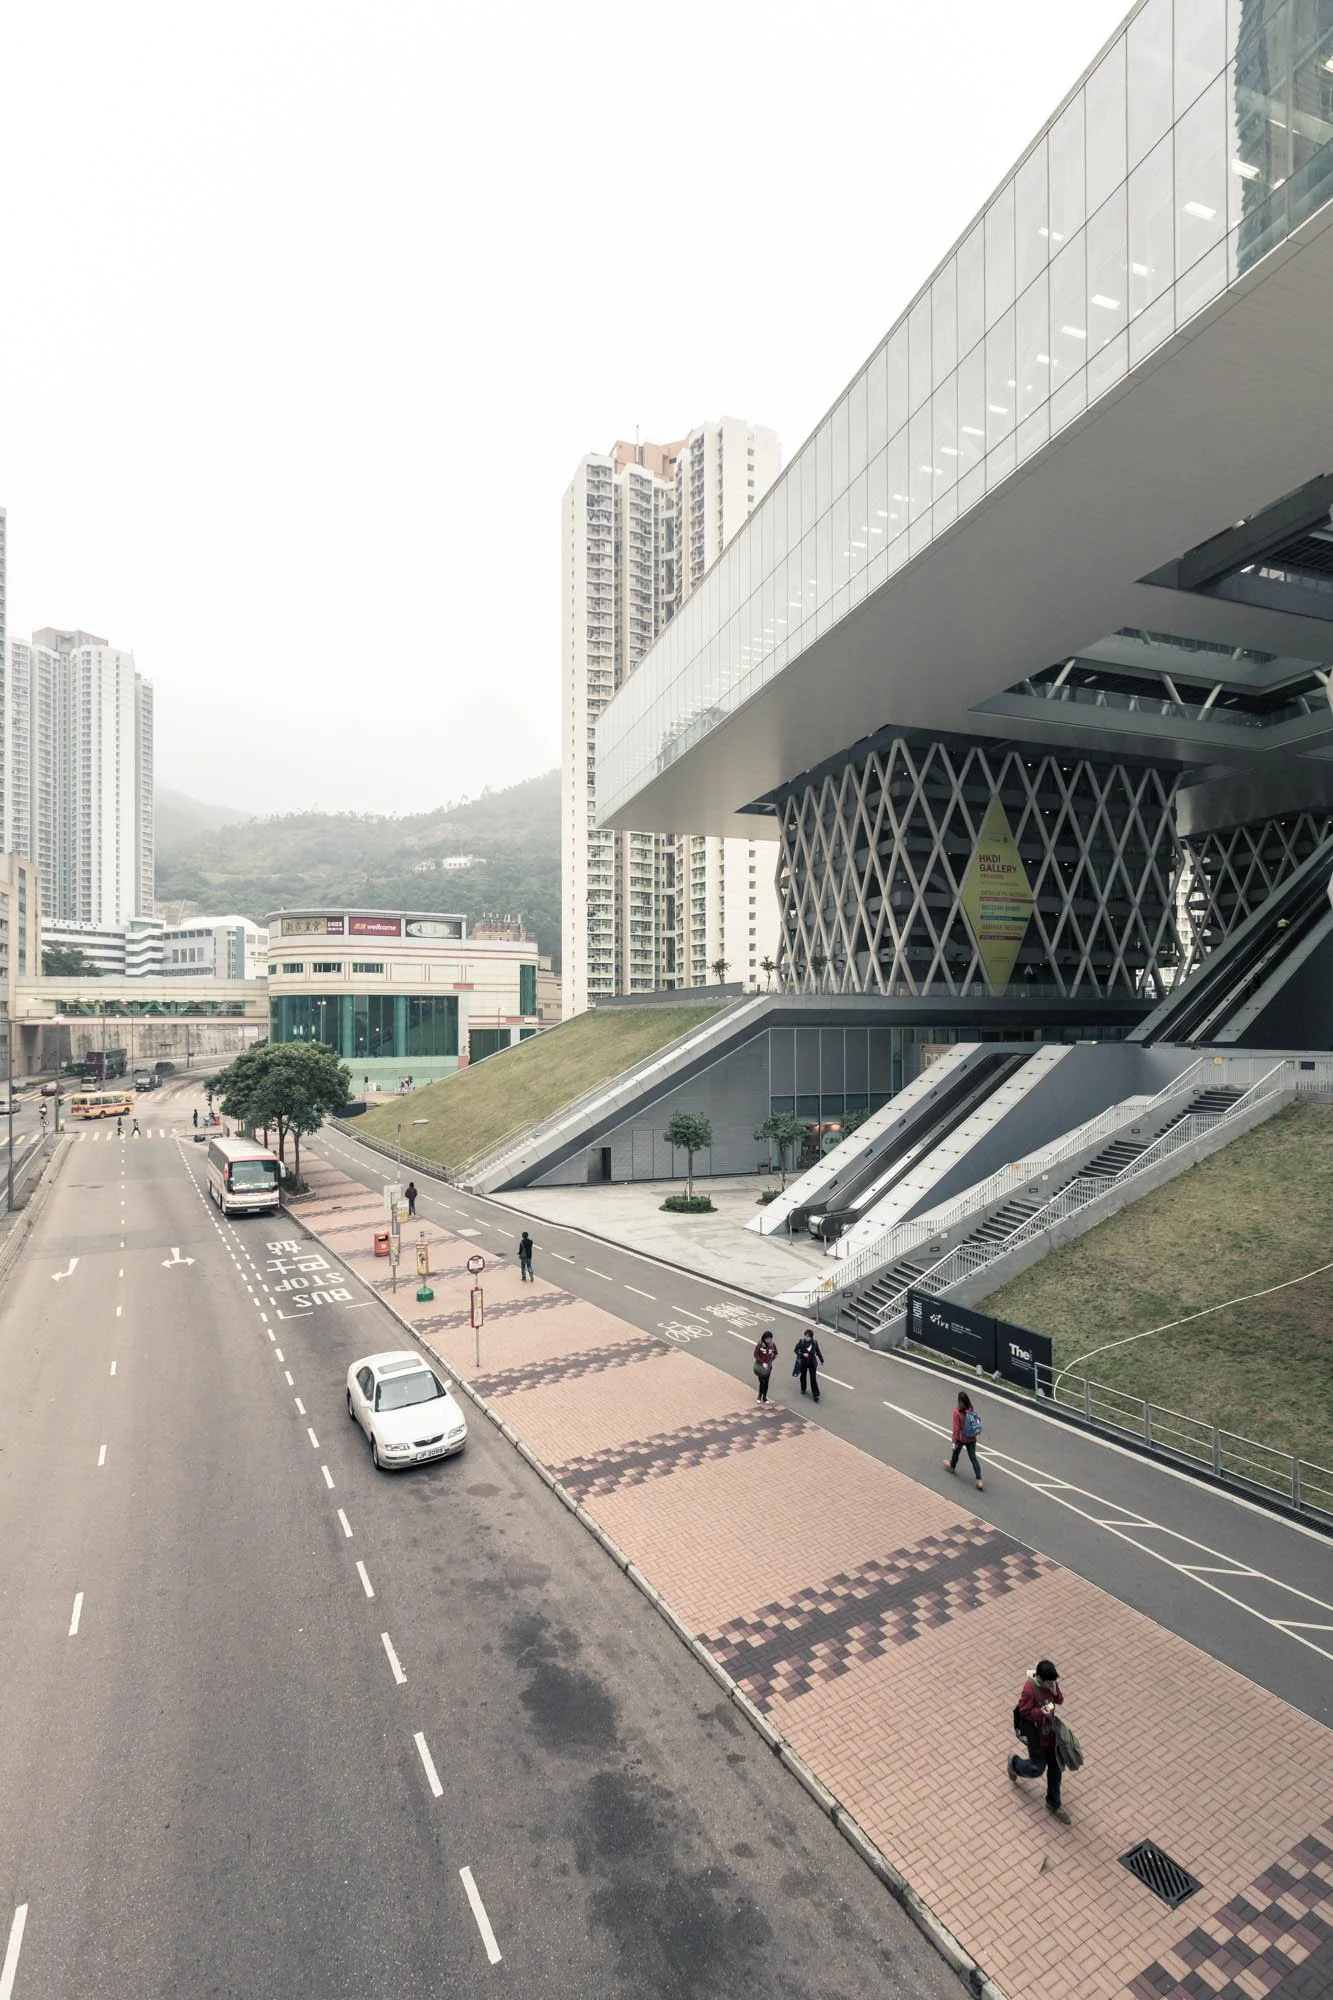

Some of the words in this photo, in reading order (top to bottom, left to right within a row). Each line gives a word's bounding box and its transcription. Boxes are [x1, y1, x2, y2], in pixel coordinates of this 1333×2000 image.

[979, 854, 1001, 863] HKDI
[979, 863, 1017, 873] GALLERY
[367, 923, 397, 931] wellcome
[266, 1254, 331, 1275] 巴士
[274, 1272, 345, 1292] STOP
[292, 1287, 353, 1308] BUS
